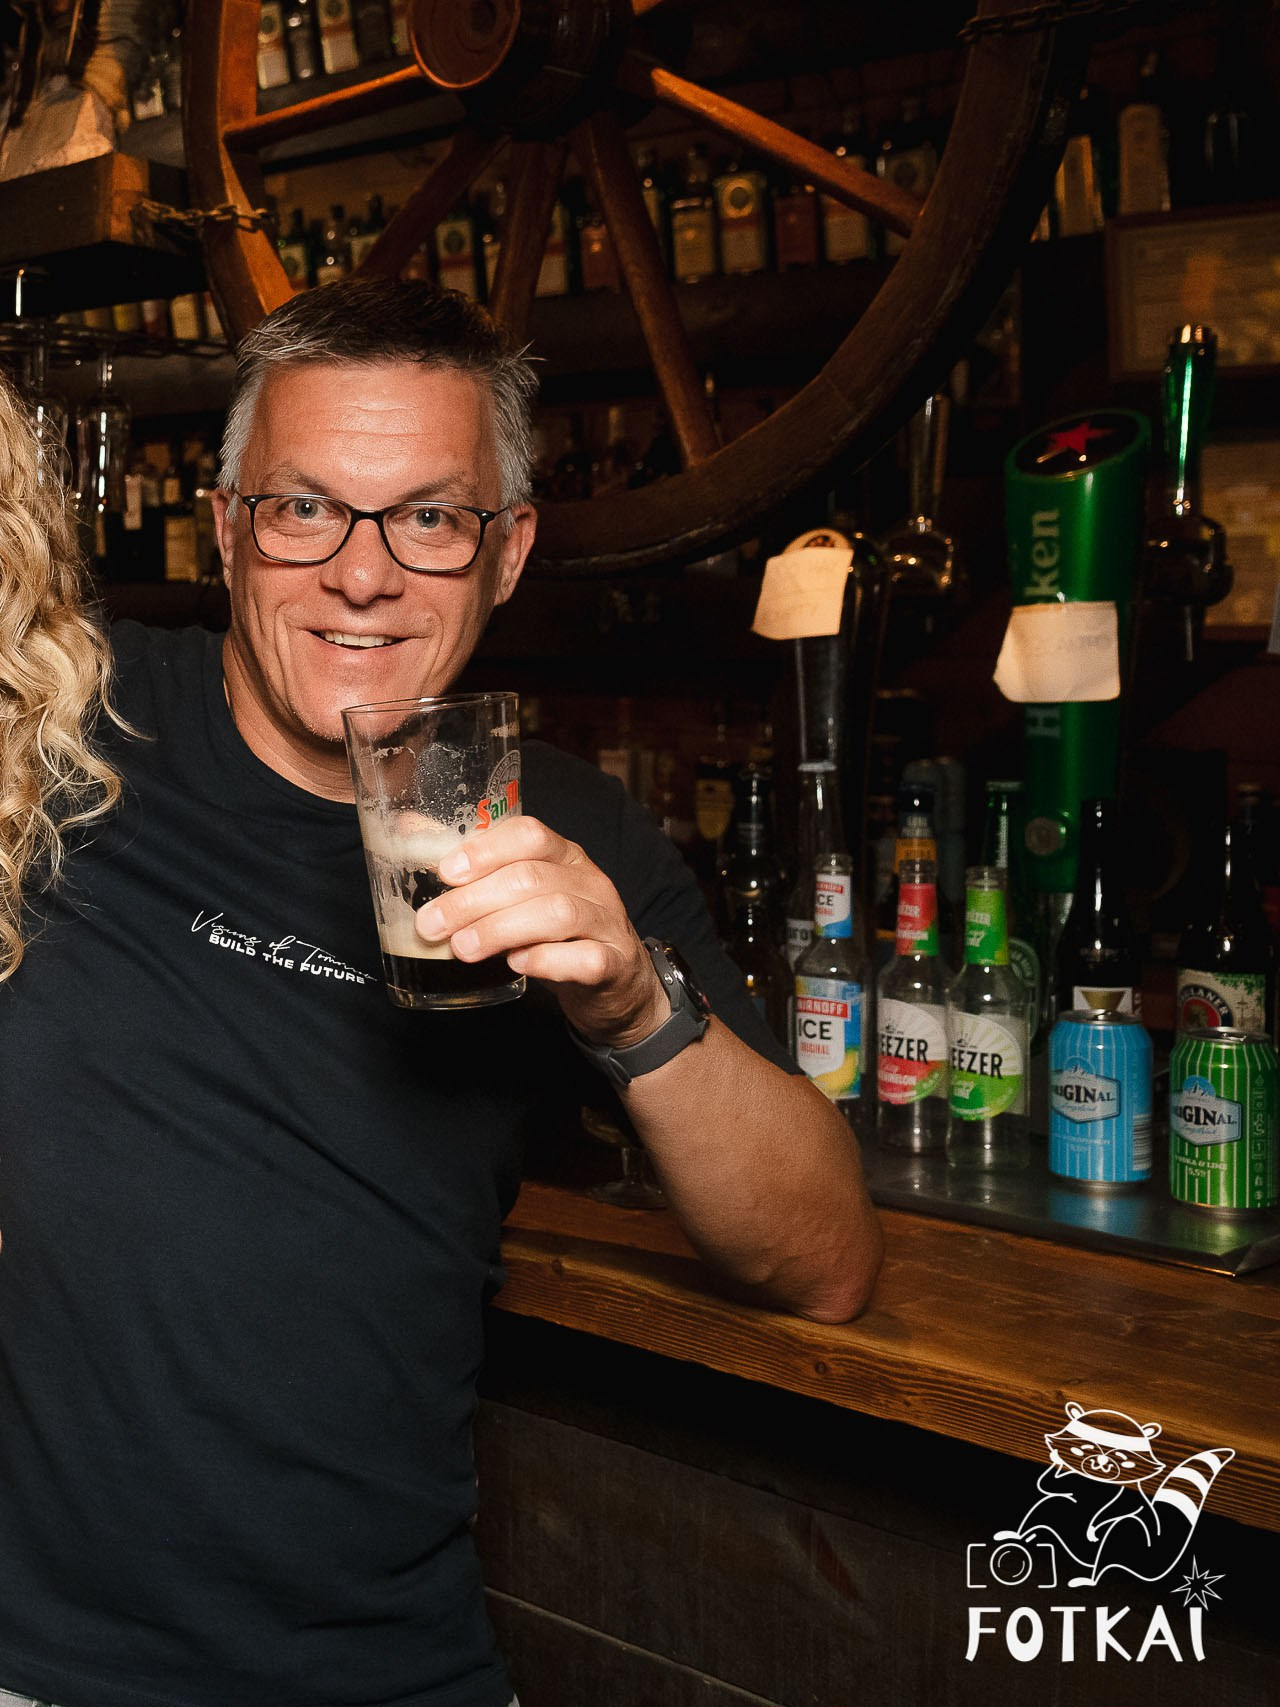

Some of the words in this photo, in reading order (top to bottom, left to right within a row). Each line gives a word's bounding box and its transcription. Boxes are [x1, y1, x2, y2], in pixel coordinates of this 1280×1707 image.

[475, 798, 508, 829] San
[816, 894, 834, 906] CE
[209, 933, 256, 957] BUILD
[262, 952, 294, 969] THE
[300, 963, 365, 984] FUTURE
[269, 935, 296, 956] of
[798, 1018, 832, 1040] ICE
[881, 1034, 928, 1064] EEZER
[951, 1048, 1004, 1079] EEZER
